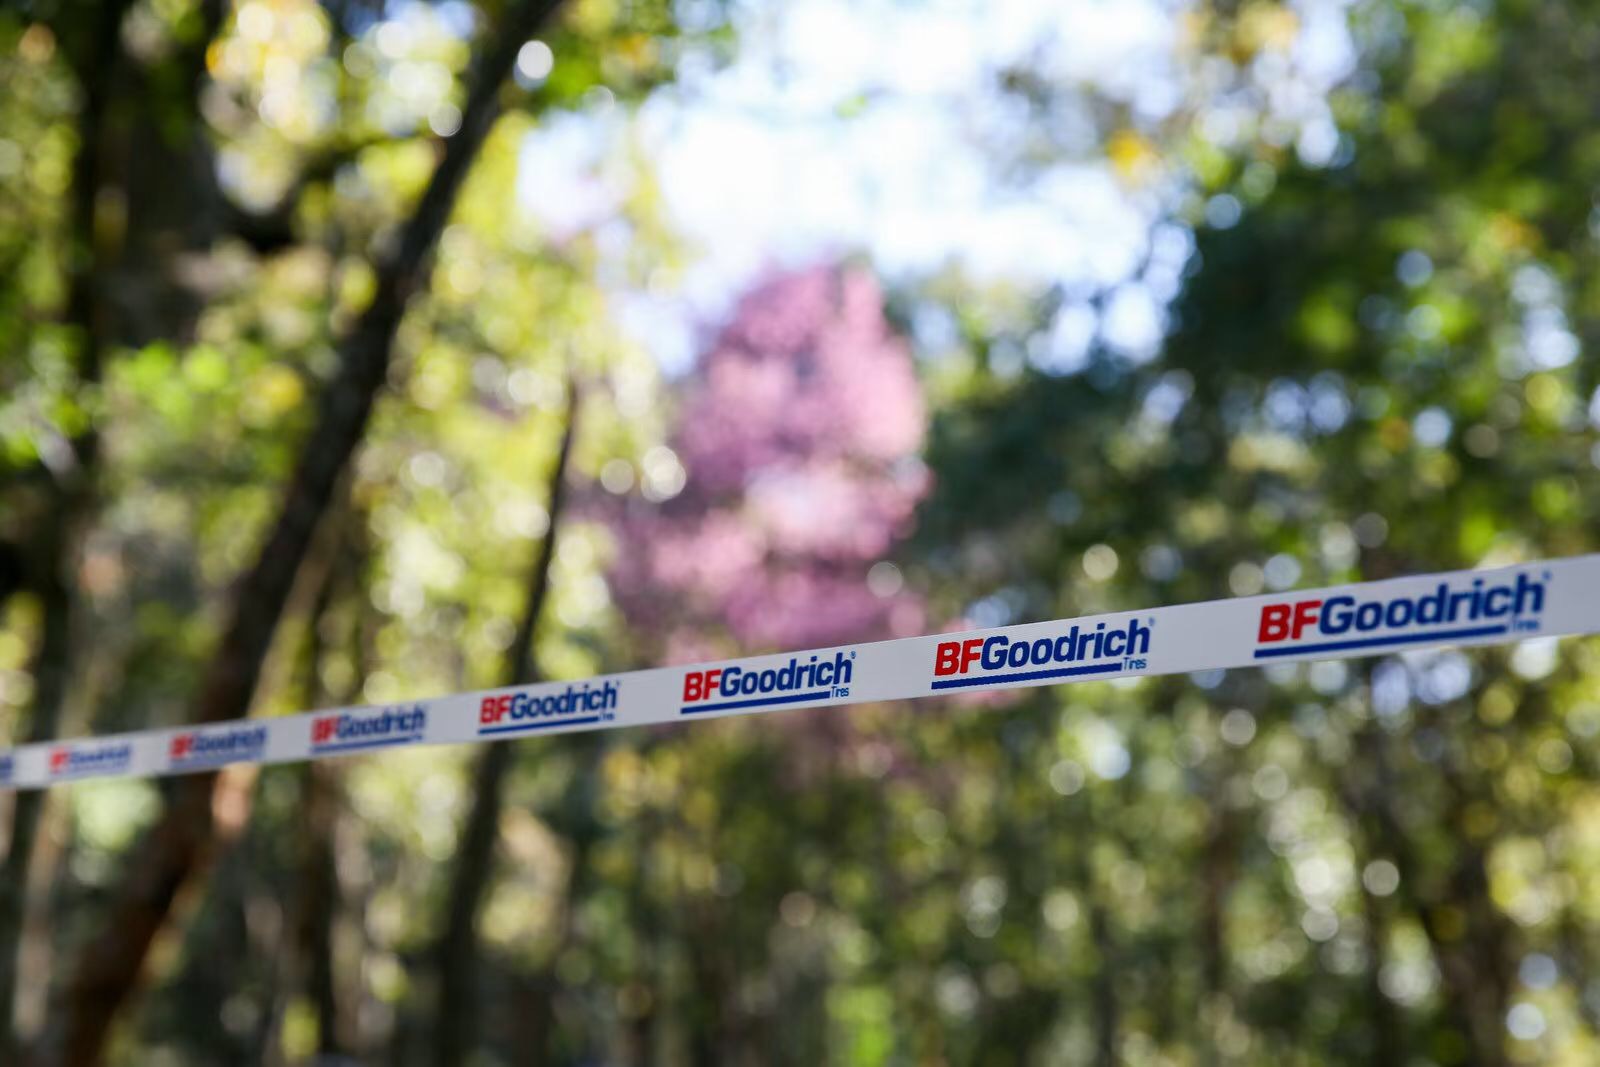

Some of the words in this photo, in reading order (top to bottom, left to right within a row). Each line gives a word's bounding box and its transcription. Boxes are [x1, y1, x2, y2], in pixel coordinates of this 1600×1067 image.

[1258, 572, 1545, 643] BFGoodrich
[934, 618, 1150, 676] BFGoodrich
[1123, 656, 1147, 671] Tires
[683, 652, 853, 702] BFGoodrich
[831, 685, 849, 699] Tires
[480, 681, 617, 724] BFGoodrich
